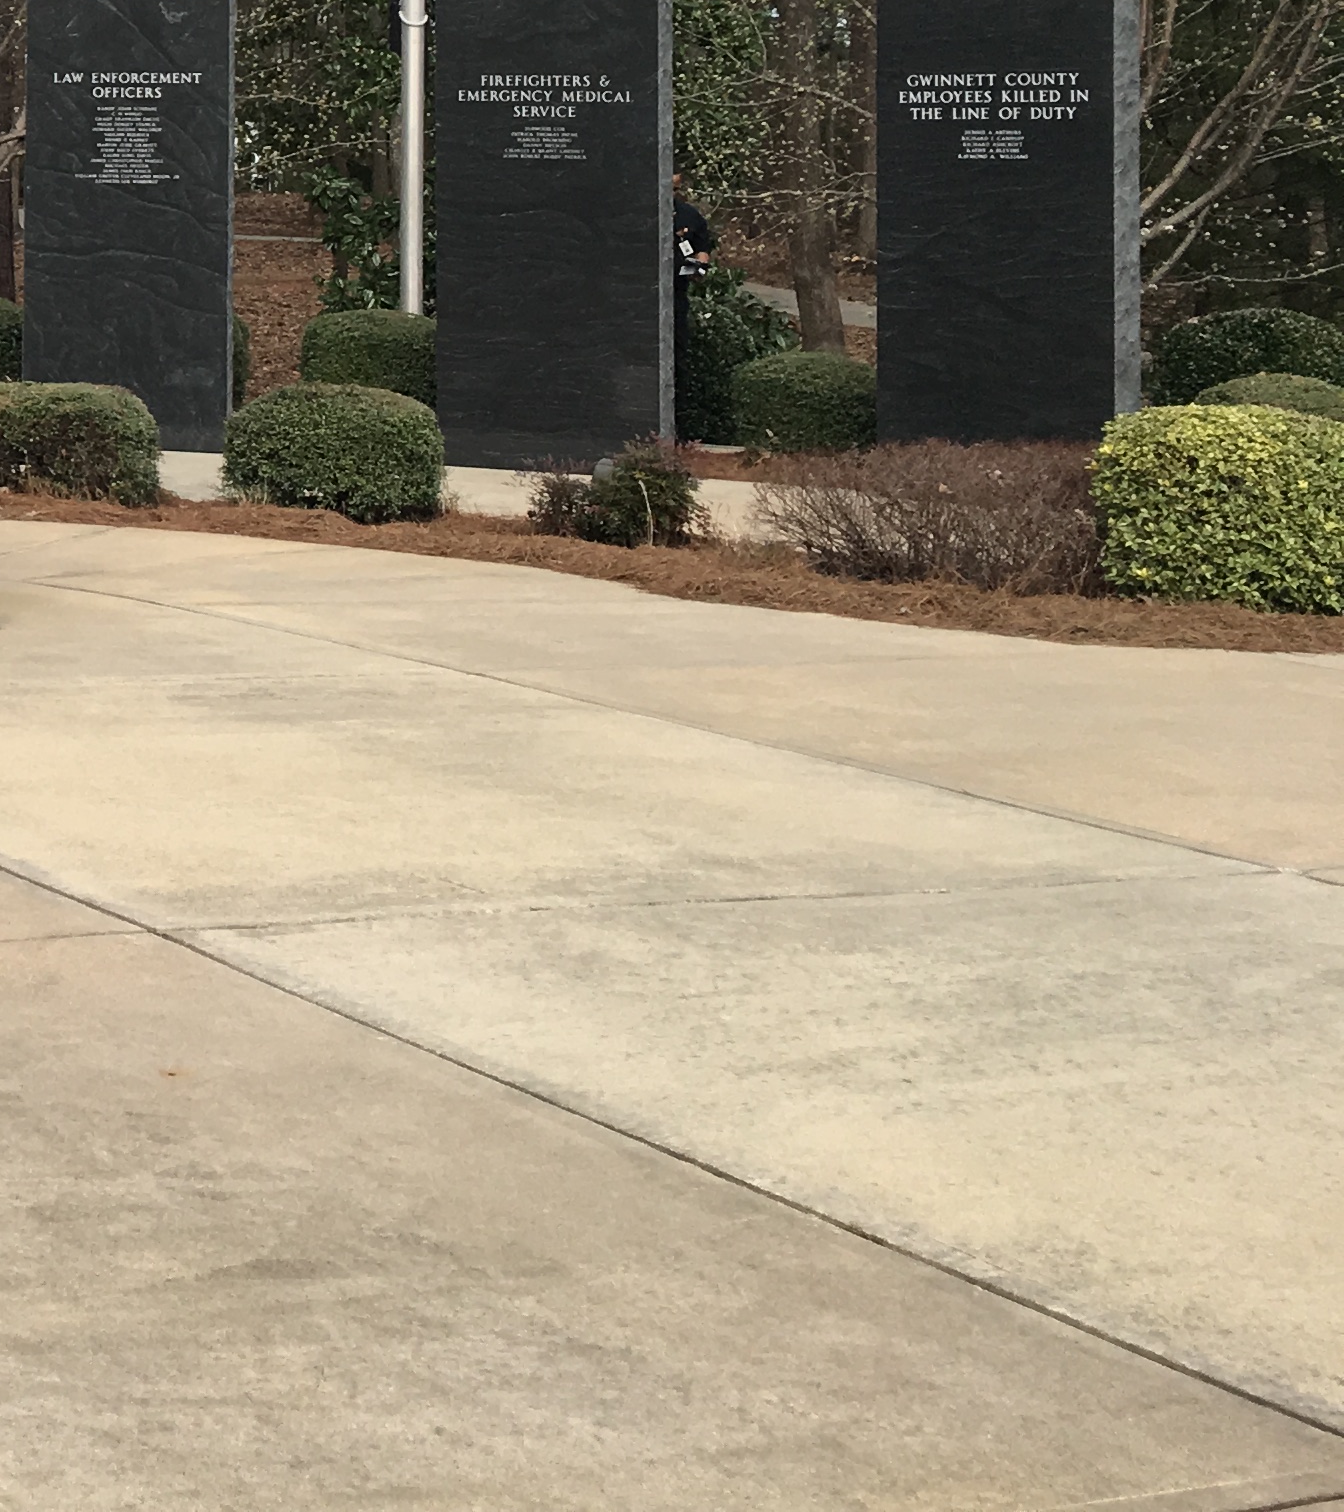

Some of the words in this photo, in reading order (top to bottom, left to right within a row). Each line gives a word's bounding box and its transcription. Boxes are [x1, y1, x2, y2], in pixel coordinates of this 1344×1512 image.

[53, 72, 84, 84] LAW
[91, 72, 202, 84] ENFORCEMENT
[481, 74, 591, 87] FIREFIGHTERS
[599, 74, 611, 87] &
[906, 73, 997, 87] GWINNETT
[1004, 72, 1079, 86] COUNTY
[92, 86, 162, 98] OFFICERS
[458, 90, 553, 102] EMERGENCY
[562, 90, 634, 103] MEDICAL
[898, 90, 992, 104] EMPLOYEES
[1001, 90, 1061, 103] KILLED
[1070, 89, 1089, 102] IN
[513, 105, 576, 118] SERVICE
[910, 107, 943, 120] THE
[952, 107, 990, 120] LINE
[998, 107, 1022, 120] OF
[1030, 107, 1077, 120] DUTY
